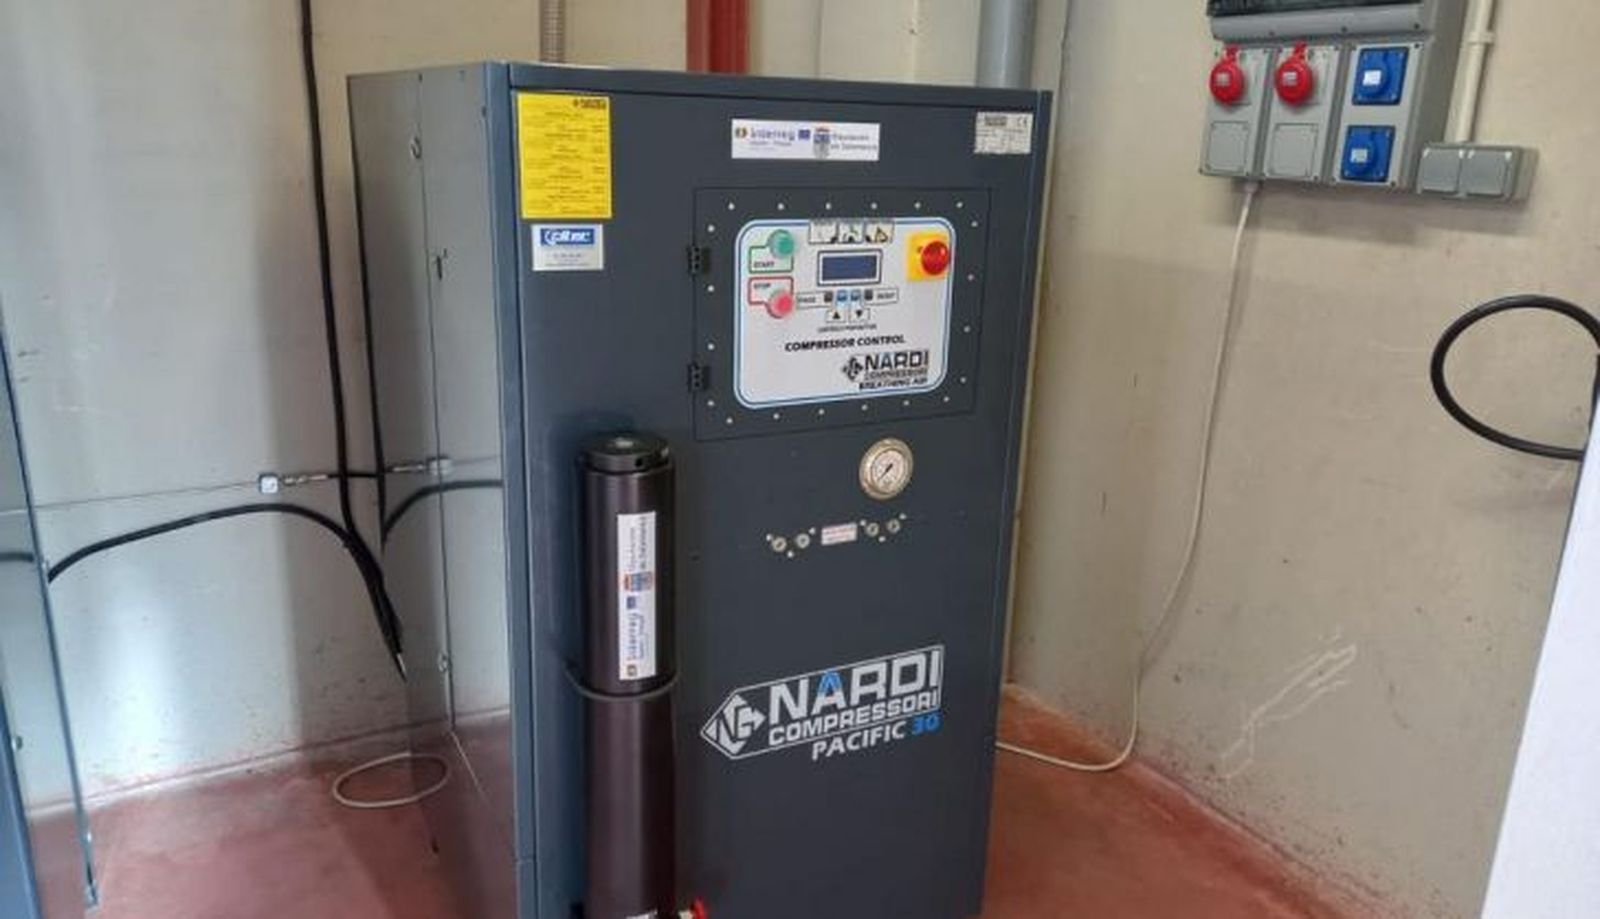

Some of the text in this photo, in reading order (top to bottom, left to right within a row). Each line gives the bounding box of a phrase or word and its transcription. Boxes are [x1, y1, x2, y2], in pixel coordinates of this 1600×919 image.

[785, 334, 906, 351] COMPRESSOR CONTROL
[865, 350, 929, 370] NARDI
[769, 649, 941, 725] NARDI
[768, 689, 939, 746] COMPRESSORI
[812, 712, 942, 761] PACIFIC 30
